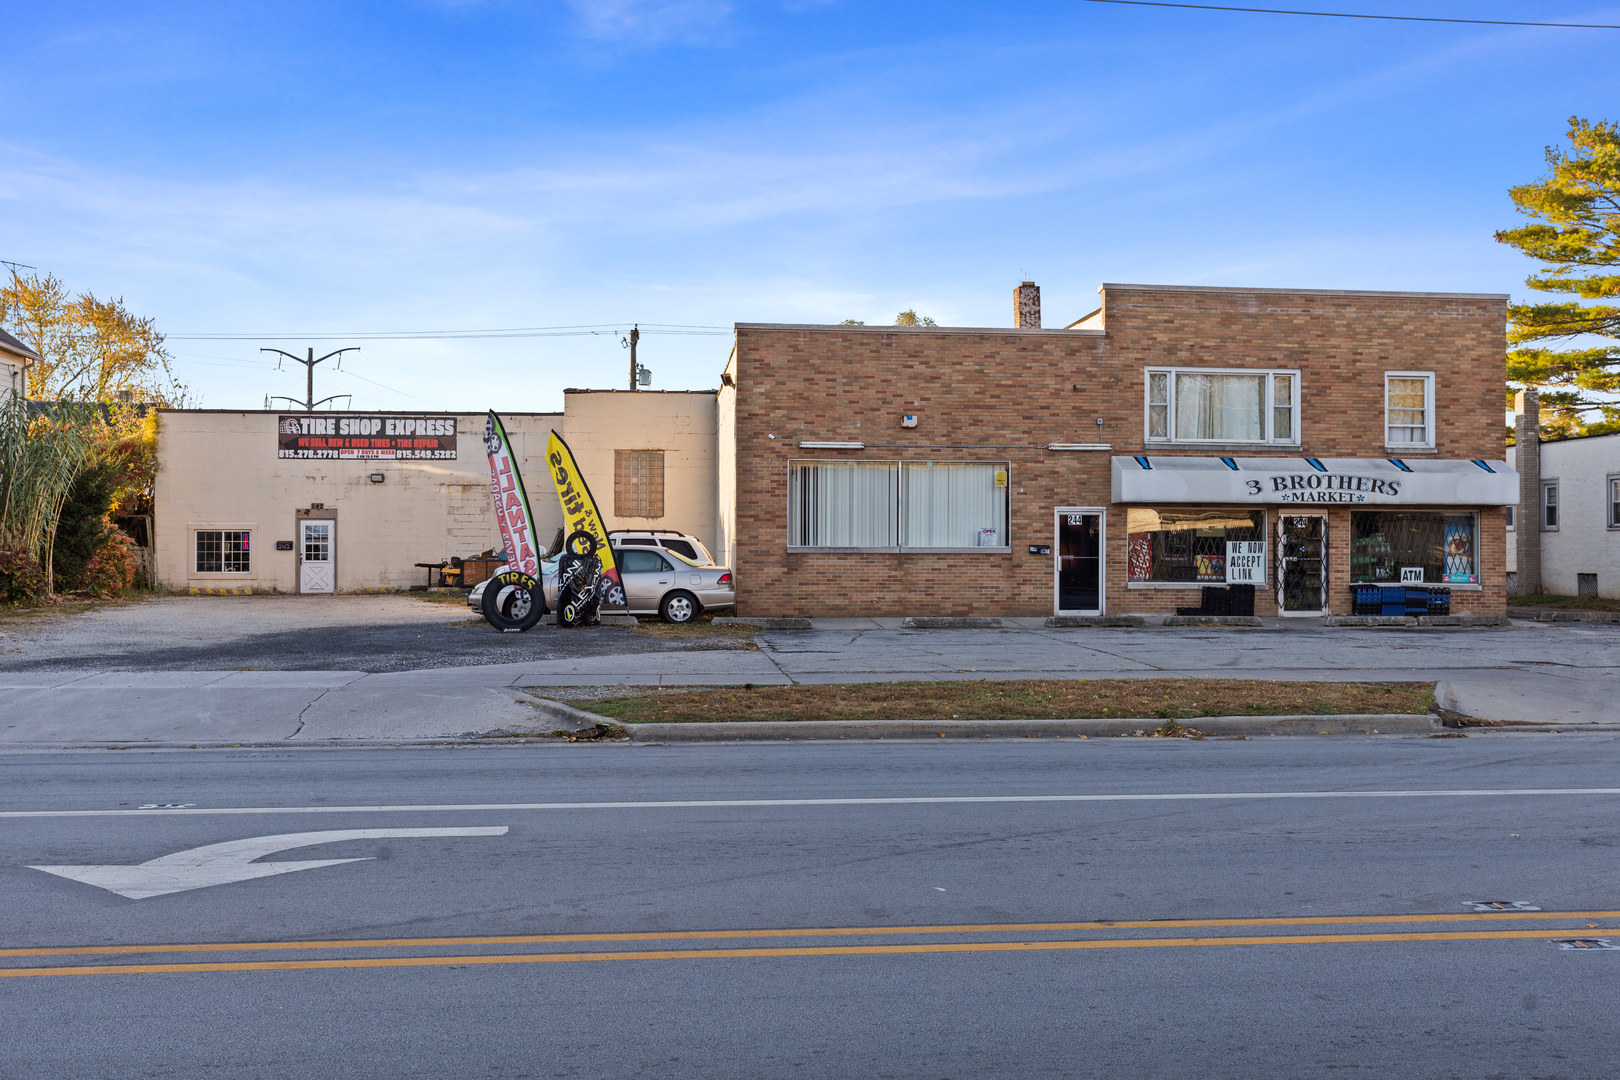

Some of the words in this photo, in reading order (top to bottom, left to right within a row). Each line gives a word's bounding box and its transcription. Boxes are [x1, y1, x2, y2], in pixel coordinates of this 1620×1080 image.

[300, 418, 336, 435] TIRE
[340, 418, 382, 435] SHOP
[385, 419, 455, 436] EXPRESS
[298, 438, 309, 447] WE
[310, 438, 327, 447] SELL
[328, 438, 344, 447] NEW
[351, 438, 370, 448] USED
[371, 439, 391, 448] TIRES
[397, 439, 413, 448] TIRE
[414, 439, 439, 448] REPAIR
[278, 449, 339, 459] 815.278.2778
[396, 450, 457, 459] 815.549.5282
[1246, 479, 1262, 496] 3
[1270, 474, 1401, 497] BROTHERS
[1291, 491, 1355, 503] MARKET
[1068, 515, 1082, 525] 244
[1231, 542, 1242, 553] WE
[1247, 542, 1263, 553] NOW
[1230, 556, 1261, 567] ACCEPT
[1231, 568, 1253, 580] LINK
[1402, 570, 1422, 582] ATM
[498, 572, 536, 590] TIRES
